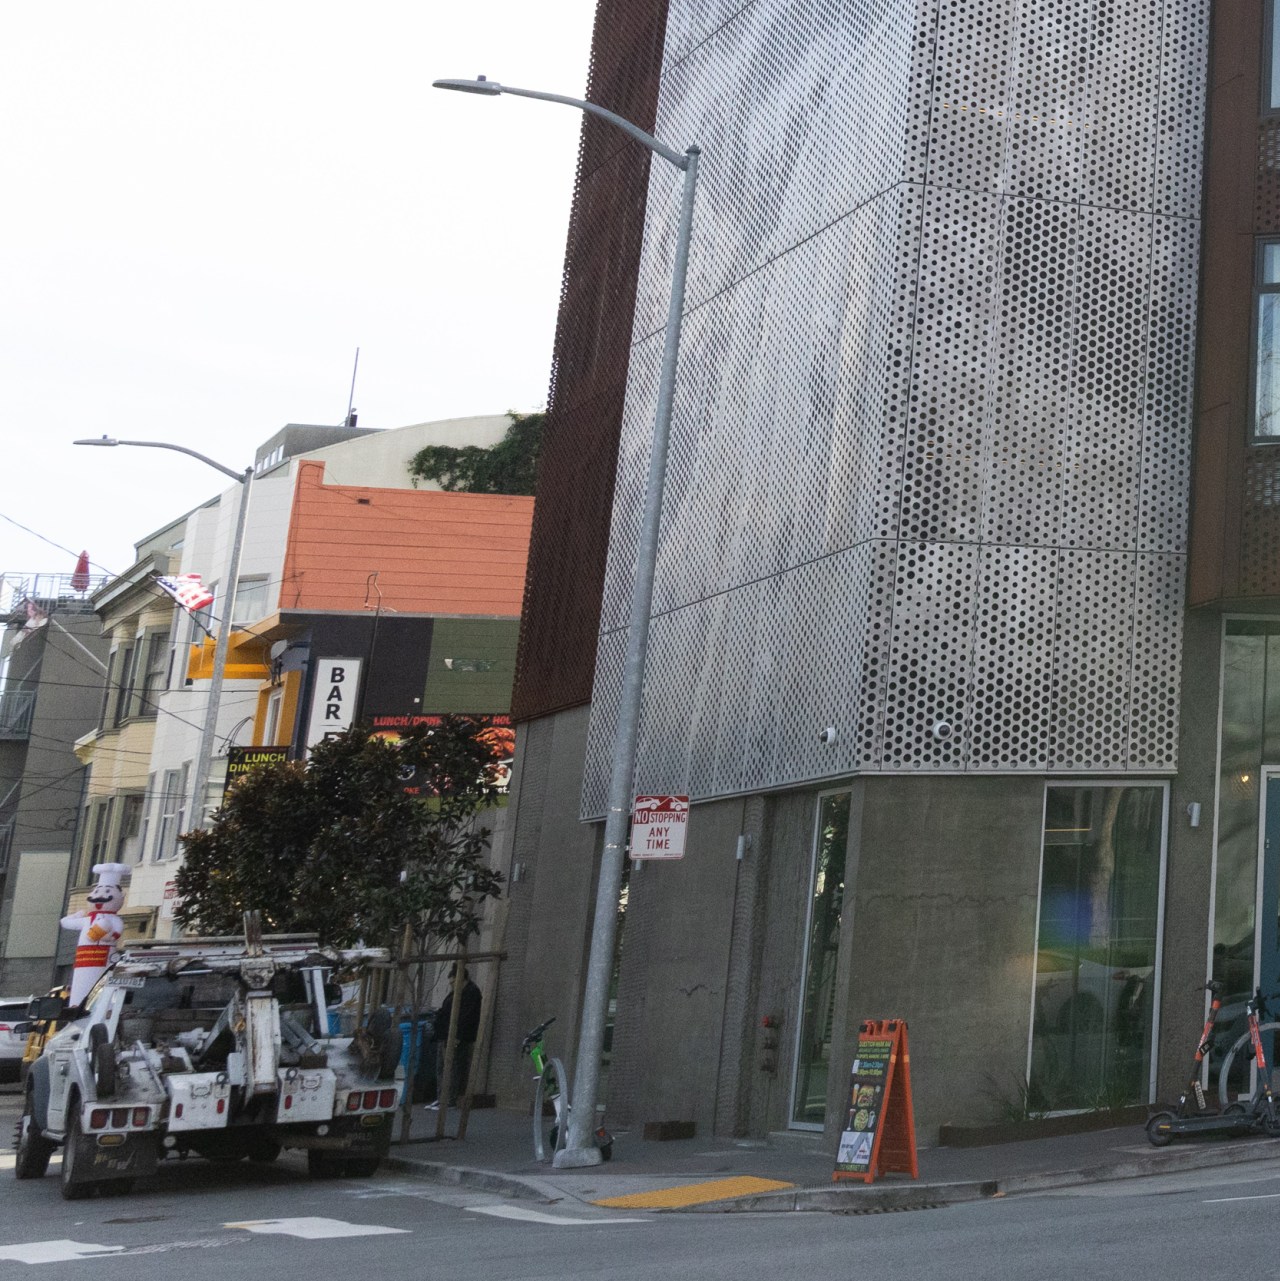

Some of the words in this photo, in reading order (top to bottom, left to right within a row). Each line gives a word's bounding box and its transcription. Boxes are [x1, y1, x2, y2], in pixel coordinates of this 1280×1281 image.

[325, 667, 345, 720] BAR
[245, 753, 286, 762] LUNCH
[633, 810, 649, 824] NO
[650, 812, 686, 824] STOPPING
[649, 827, 670, 837] ANY
[646, 839, 670, 850] TIME
